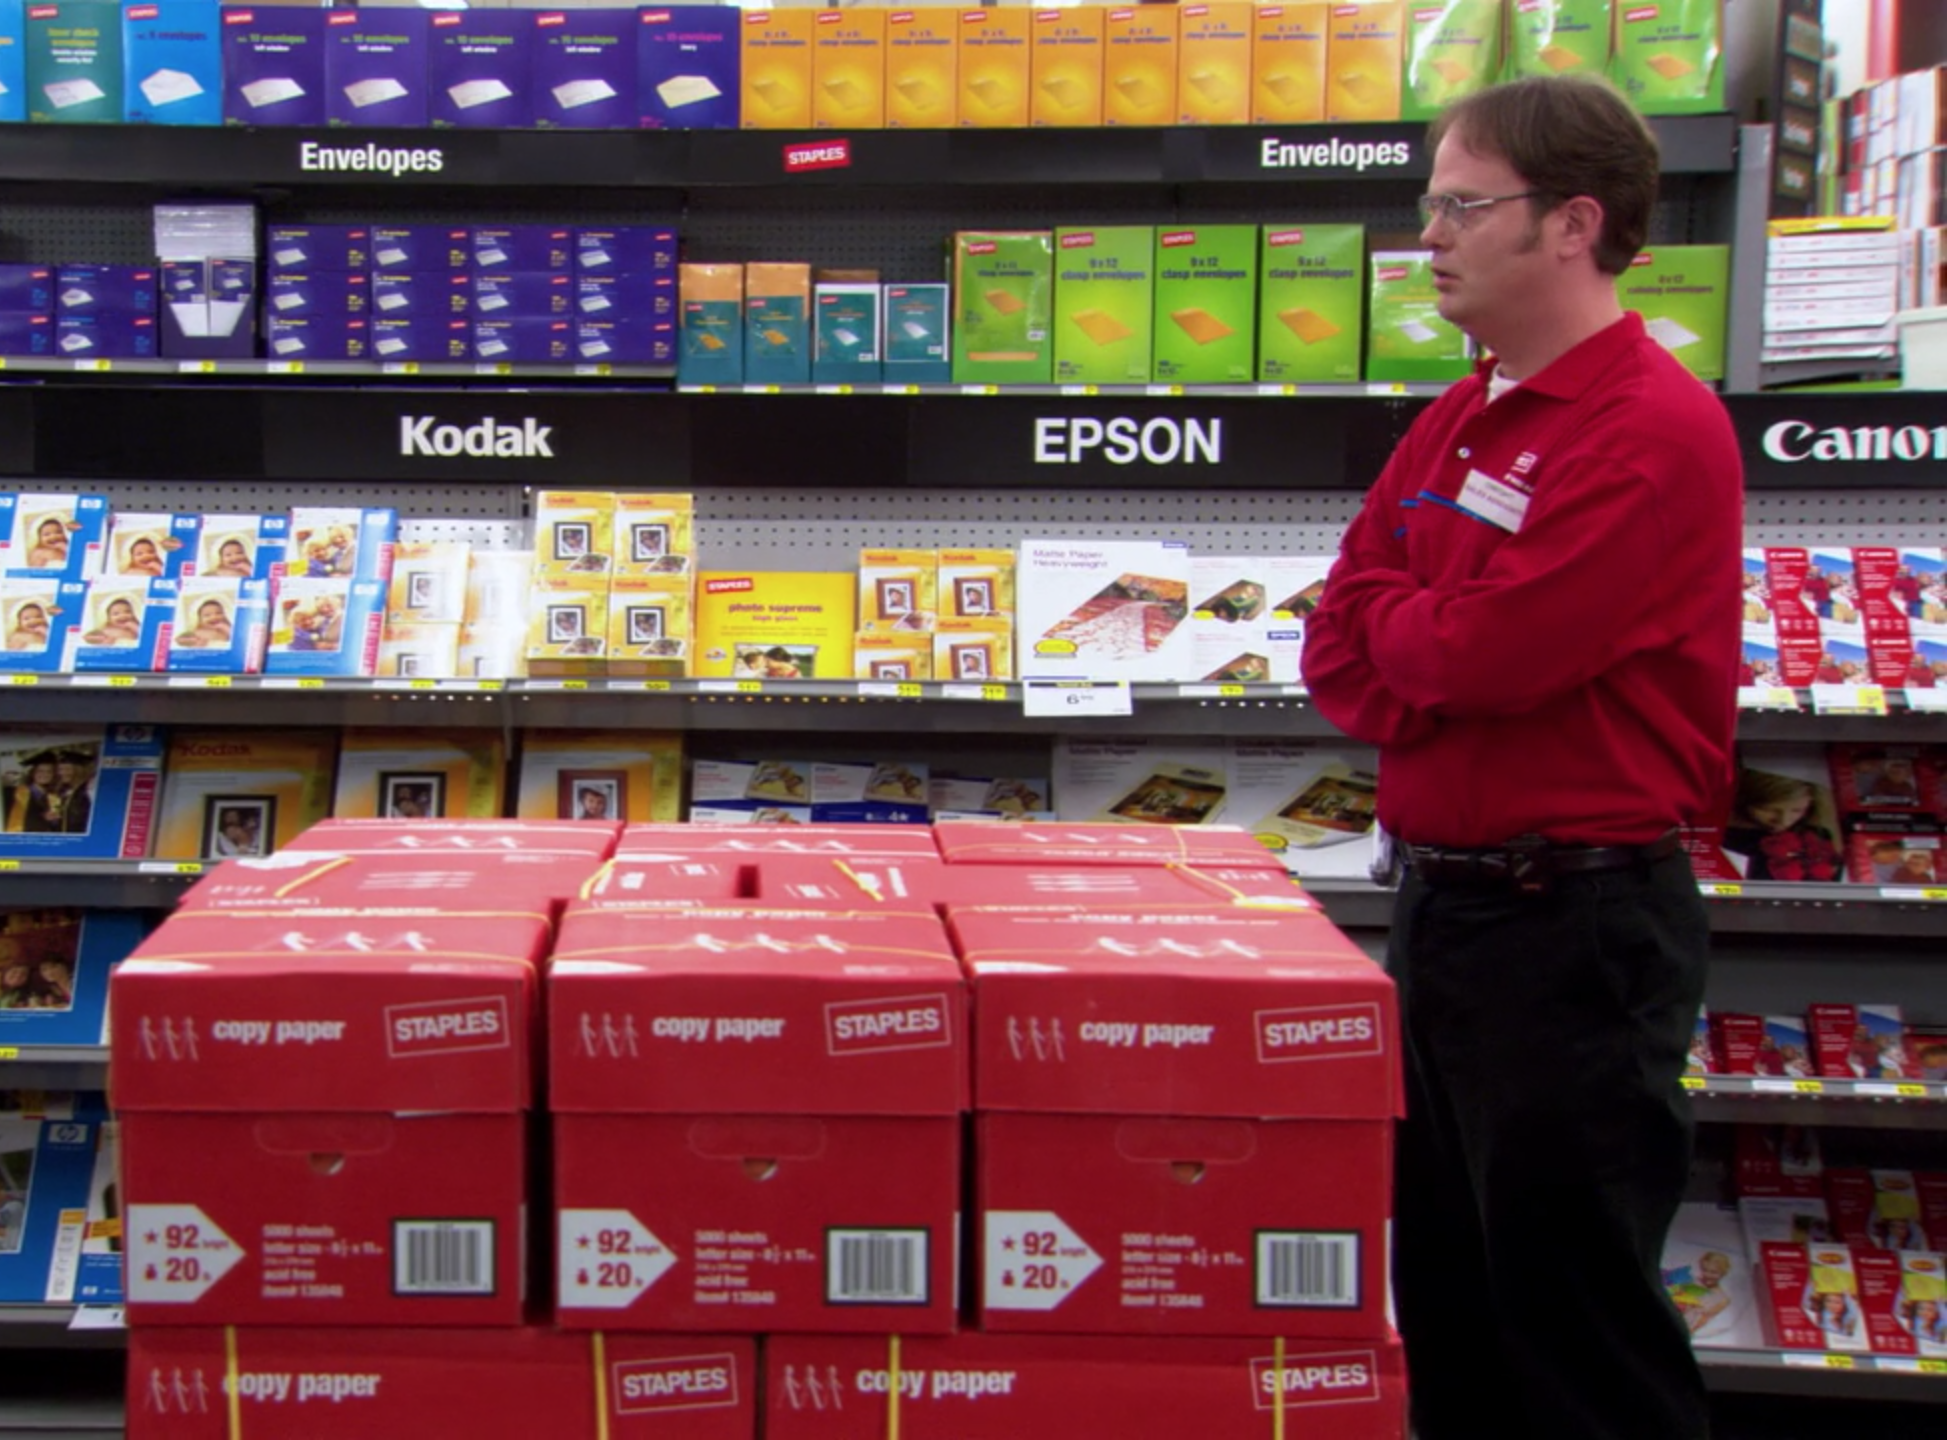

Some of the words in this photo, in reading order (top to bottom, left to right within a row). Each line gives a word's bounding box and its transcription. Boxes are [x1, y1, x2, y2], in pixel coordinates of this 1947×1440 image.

[300, 142, 443, 175] Envelopes
[788, 145, 846, 165] STAPLES
[1260, 138, 1410, 170] Envelopes
[1162, 268, 1190, 280] clasp
[1193, 268, 1246, 280] envelopes
[400, 414, 554, 458] Kodak
[1034, 417, 1222, 463] EPSON
[1032, 549, 1066, 559] Matte
[1068, 550, 1104, 562] Paper
[1032, 560, 1108, 571] Heavyweight
[728, 603, 764, 614] photo
[768, 603, 823, 614] supreme
[212, 1018, 269, 1045] copy
[275, 1019, 346, 1045] paper
[395, 1010, 499, 1041] STAPLES
[651, 1016, 709, 1042] copy
[715, 1018, 785, 1043] paper
[835, 1008, 940, 1040] STAPLES
[1079, 1020, 1137, 1047] copy
[1142, 1022, 1214, 1048] paper
[1265, 1016, 1372, 1048] STAPLES
[165, 1224, 200, 1250] 92
[295, 1224, 335, 1237] sheets
[597, 1228, 632, 1255] 92
[728, 1230, 768, 1244] sheets
[1022, 1230, 1057, 1257] 92
[1155, 1234, 1195, 1247] sheets
[165, 1256, 201, 1282] 20
[597, 1261, 632, 1288] 20
[1022, 1264, 1058, 1290] 20
[298, 1373, 381, 1402] paper
[623, 1367, 729, 1397] STAPLES
[931, 1370, 1016, 1399] paper
